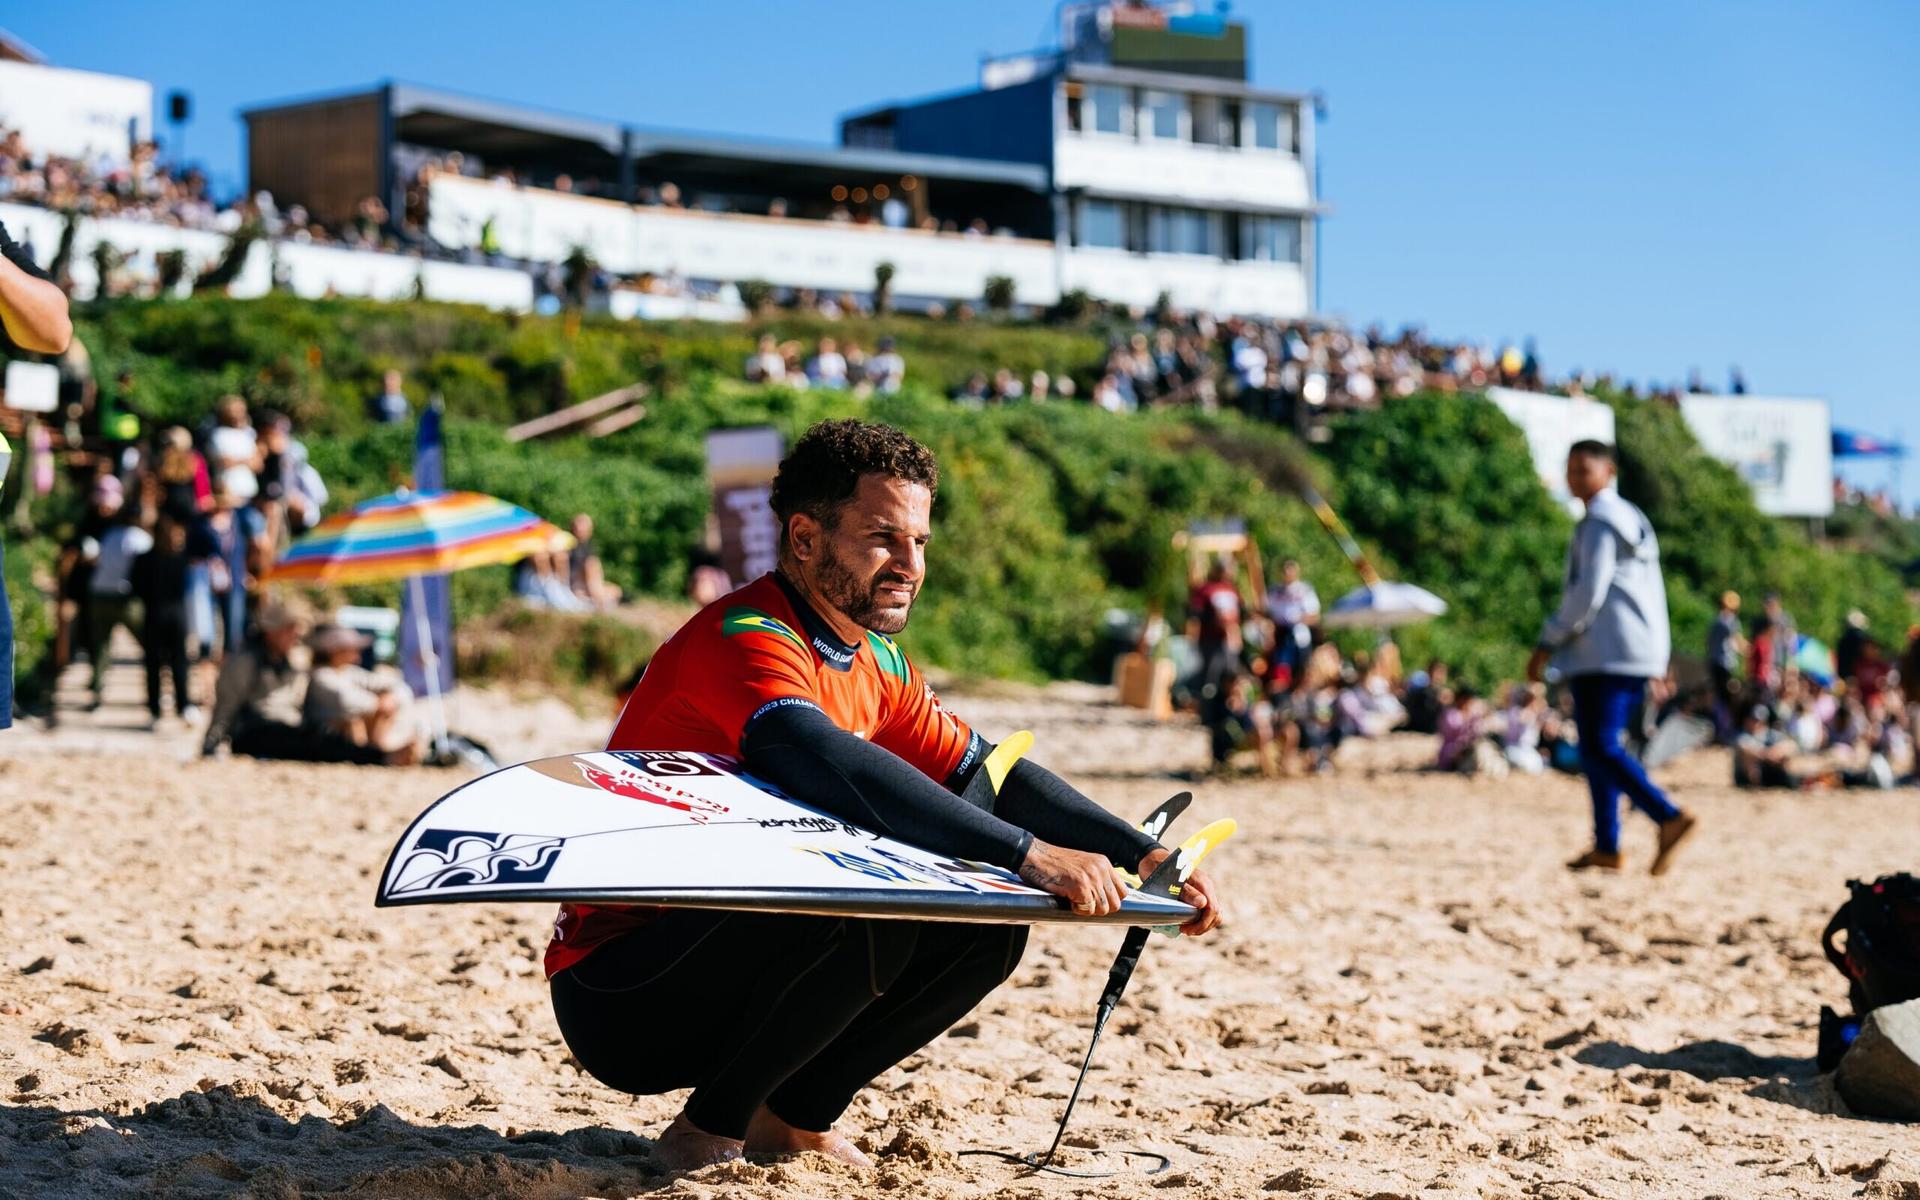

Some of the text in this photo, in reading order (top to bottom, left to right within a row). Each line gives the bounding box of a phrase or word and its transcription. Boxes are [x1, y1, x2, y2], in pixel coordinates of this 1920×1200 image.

[813, 636, 841, 661] WORLD
[753, 700, 778, 719] 2023
[612, 751, 689, 761] OAKLEY
[957, 750, 975, 775] 2023
